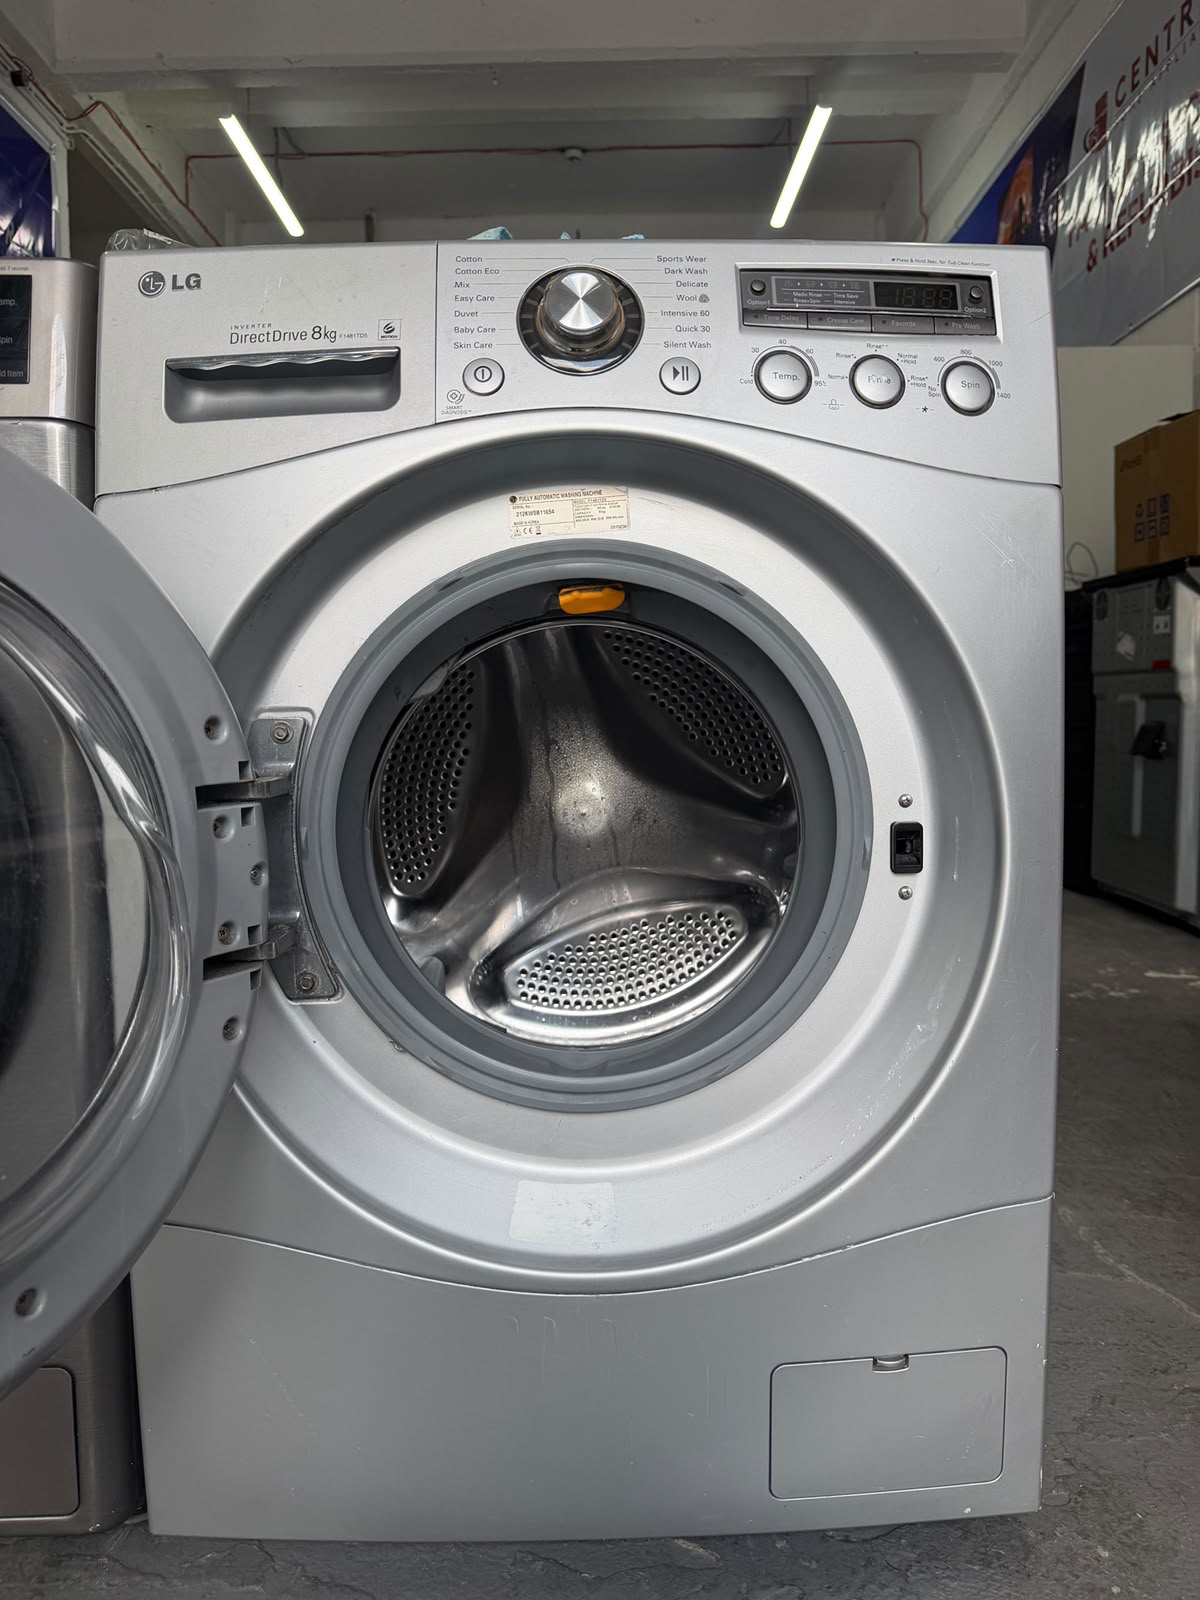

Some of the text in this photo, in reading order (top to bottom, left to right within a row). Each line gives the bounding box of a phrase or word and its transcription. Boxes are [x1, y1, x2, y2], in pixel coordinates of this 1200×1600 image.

[455, 255, 482, 263] Cotton
[657, 255, 707, 263] Sports Wear
[455, 267, 500, 275] Cotton Eco
[664, 267, 708, 275] Dark Wash
[172, 272, 202, 291] LG
[454, 281, 470, 289] Mix
[676, 280, 708, 288] Delicate
[454, 294, 495, 303] Easy Care
[676, 294, 697, 302] Wool
[454, 310, 478, 318] Duvet
[661, 310, 698, 318] Intensive
[230, 322, 272, 330] INVERTER
[454, 326, 474, 334] Baby
[675, 325, 711, 333] Quick 30
[453, 341, 493, 349] Skin Care
[663, 341, 711, 349] Silent Wash
[7, 369, 24, 377] Item
[772, 372, 800, 382] Temp.
[961, 381, 980, 389] Spin
